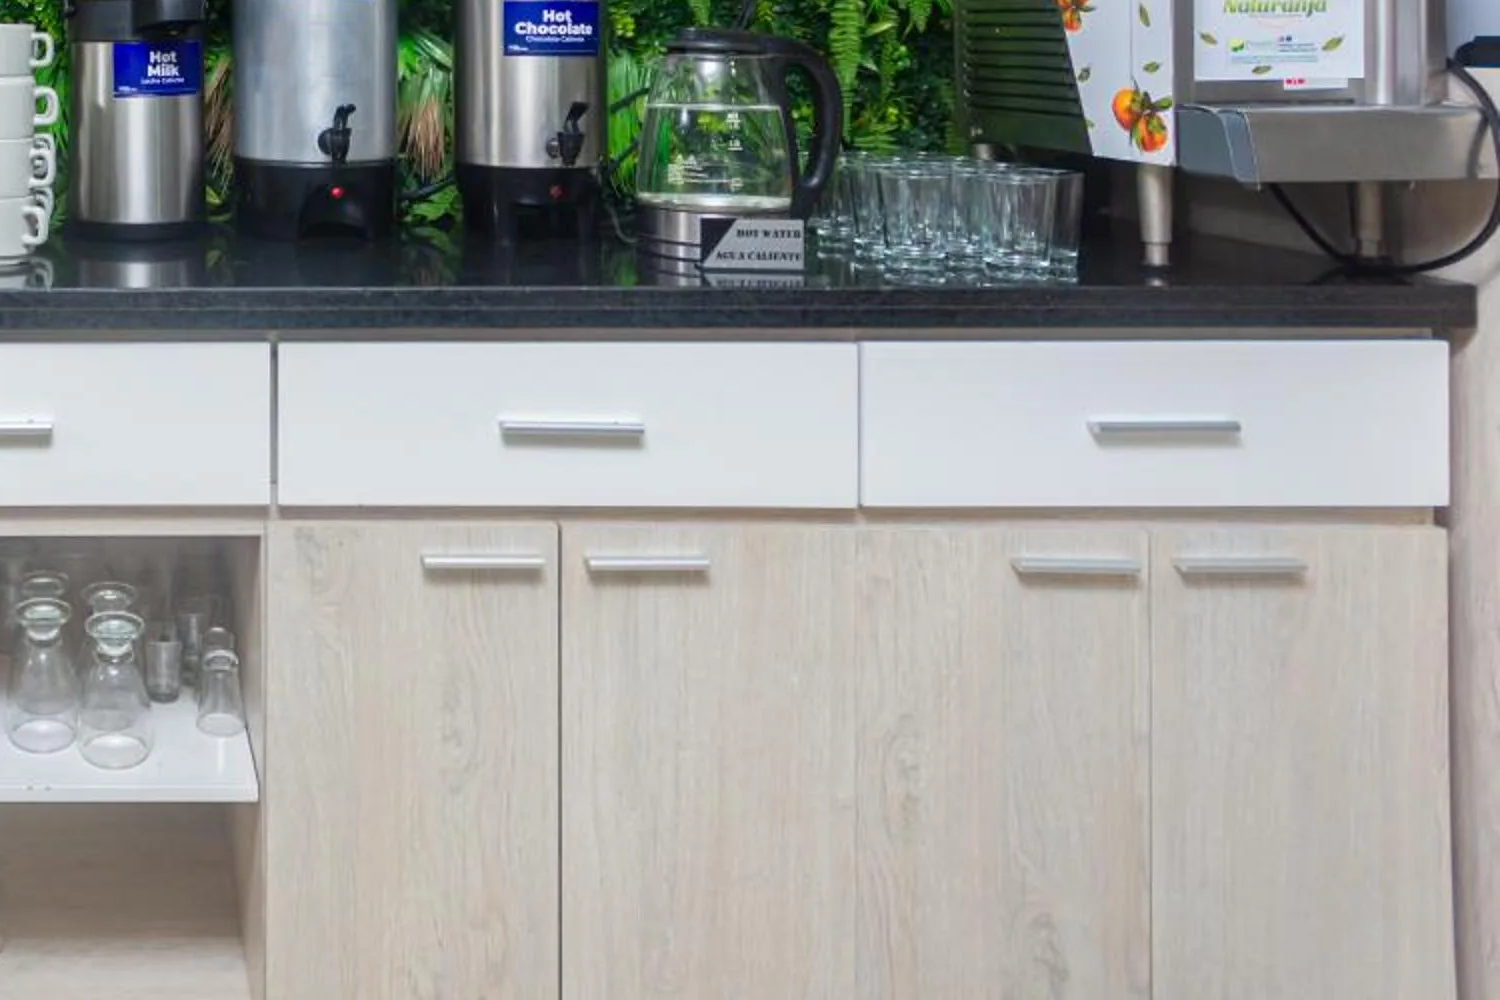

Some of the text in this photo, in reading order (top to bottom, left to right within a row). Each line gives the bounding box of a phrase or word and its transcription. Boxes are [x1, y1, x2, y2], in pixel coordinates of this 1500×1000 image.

[543, 9, 572, 22] Hot
[514, 21, 593, 35] Chocolate
[149, 51, 178, 63] Hot
[147, 64, 180, 77] Milk
[736, 229, 801, 238] HOT WATER
